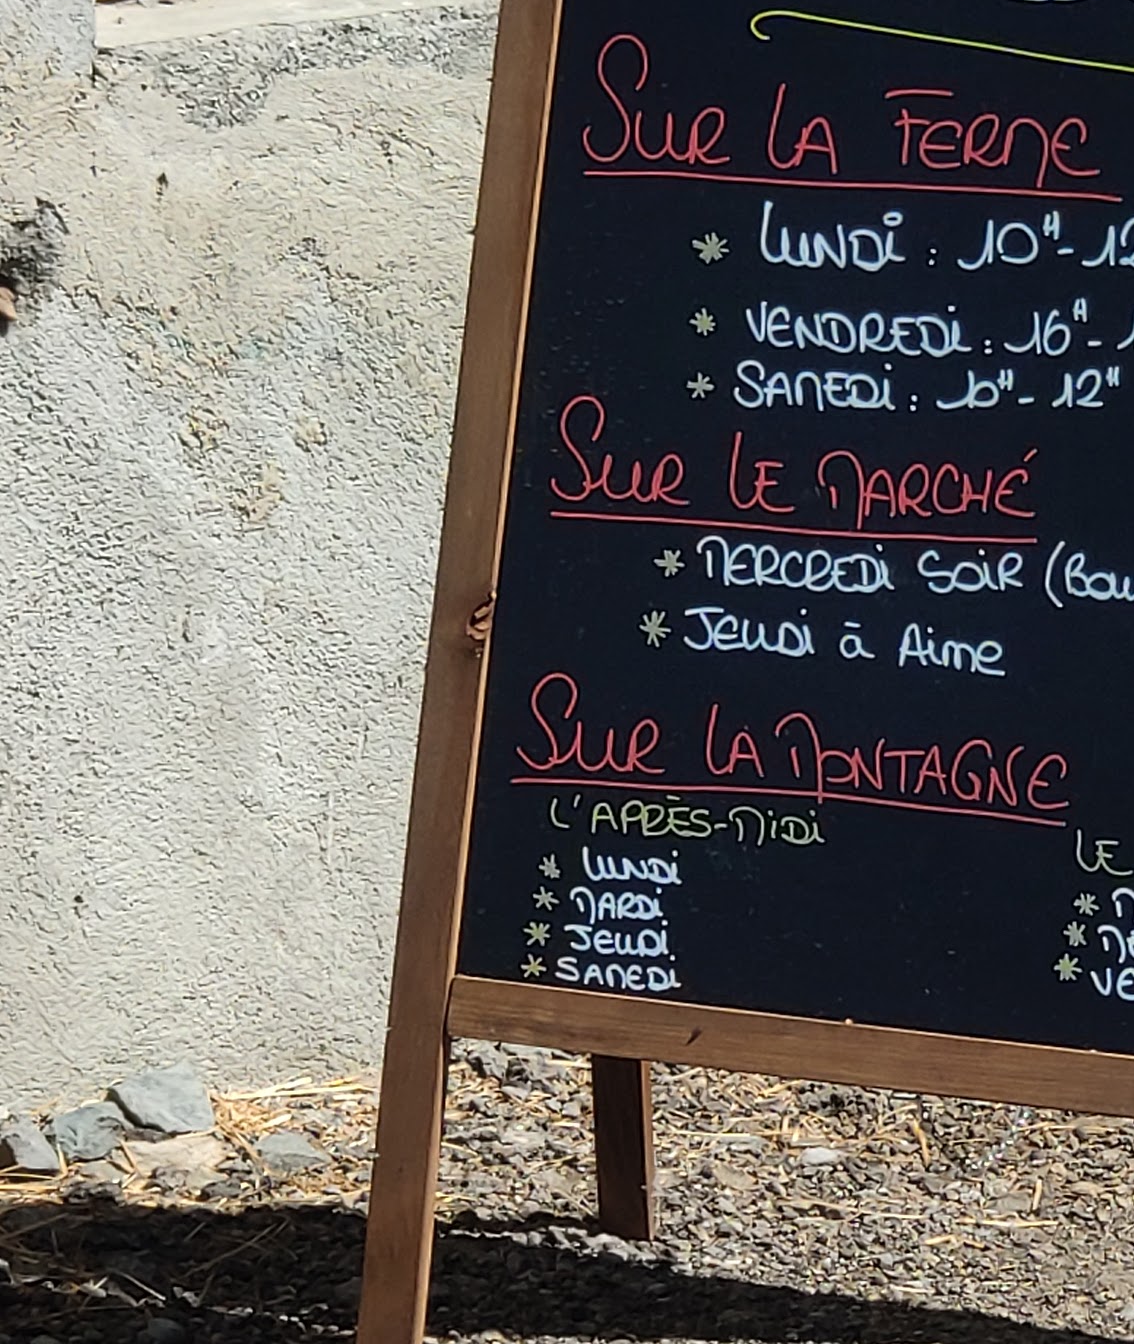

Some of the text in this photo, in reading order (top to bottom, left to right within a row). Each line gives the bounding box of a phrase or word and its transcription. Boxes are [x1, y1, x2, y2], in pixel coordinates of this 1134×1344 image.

[583, 33, 1102, 188] SUR LA FERME
[550, 394, 1039, 531] SUR LE MARCHÉ
[516, 672, 1070, 810] SUR LA MONTAGNE
[1075, 828, 1134, 876] LE
